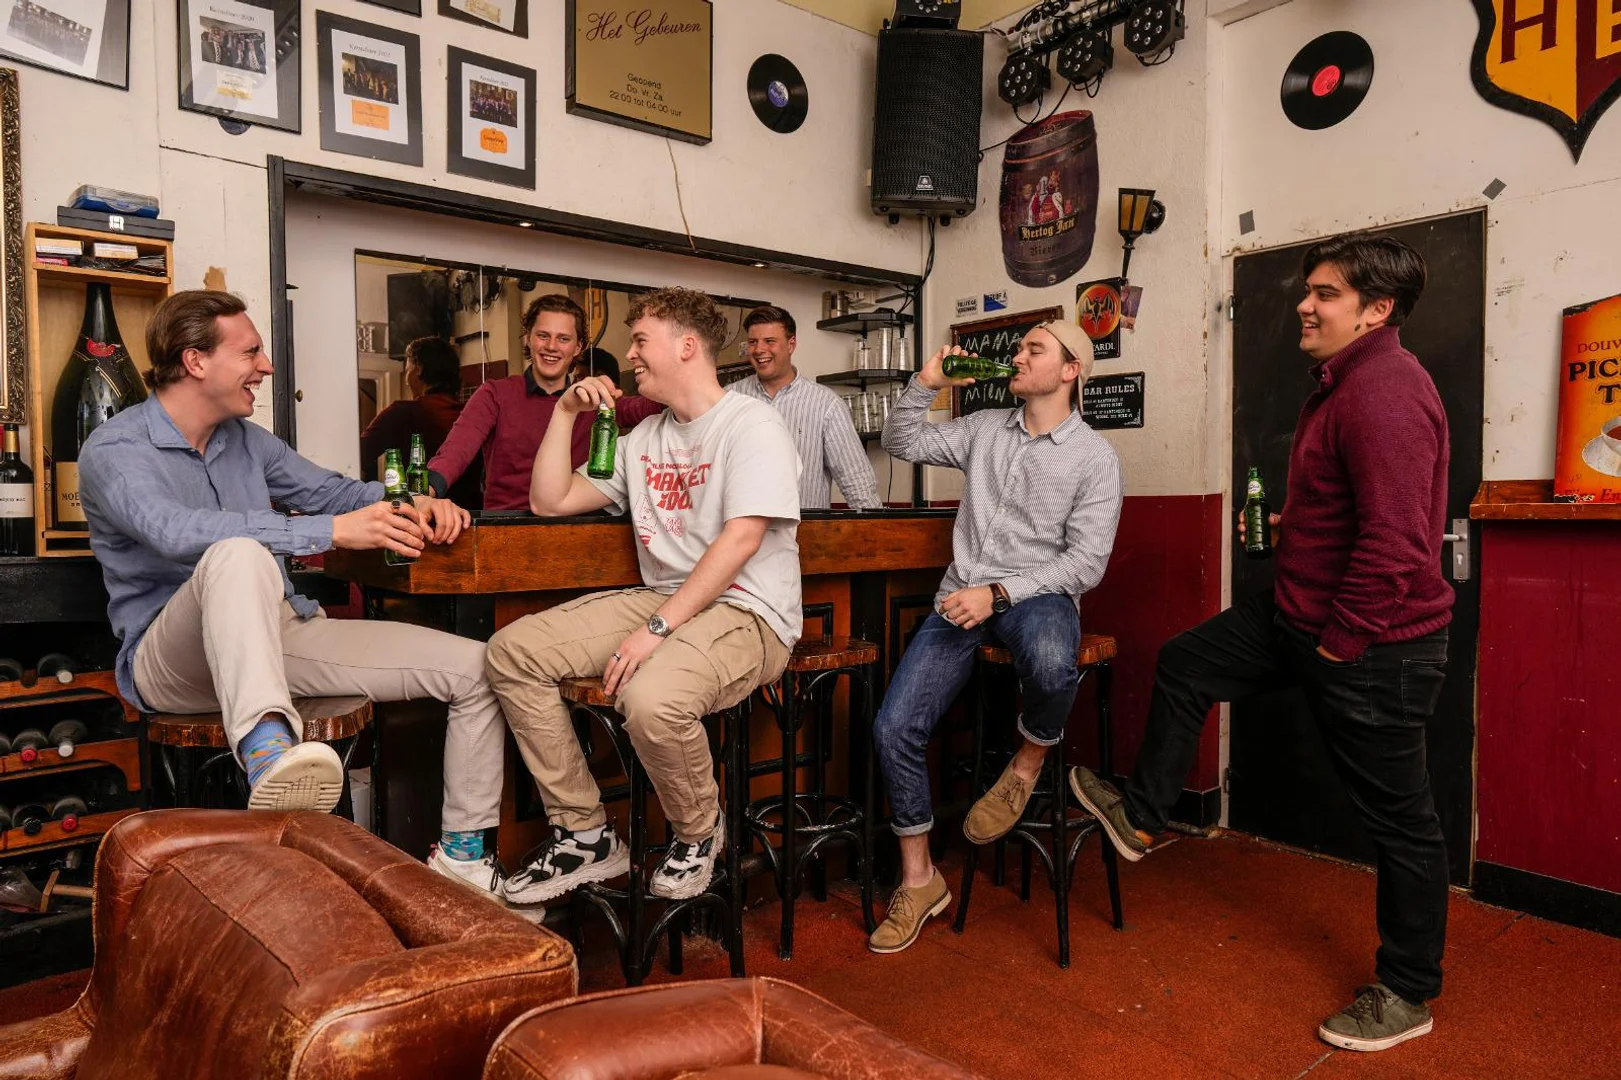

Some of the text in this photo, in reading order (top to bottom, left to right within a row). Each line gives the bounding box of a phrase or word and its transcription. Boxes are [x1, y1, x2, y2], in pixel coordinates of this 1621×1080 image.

[586, 9, 702, 46] Het Gebeuren
[627, 72, 662, 90] Geopend
[634, 98, 644, 107] tot
[670, 109, 682, 117] uur
[1021, 217, 1075, 240] Hertog Jan
[1093, 342, 1116, 352] ARDI.
[1568, 358, 1621, 382] PIC
[1084, 384, 1135, 396] BAR RULES
